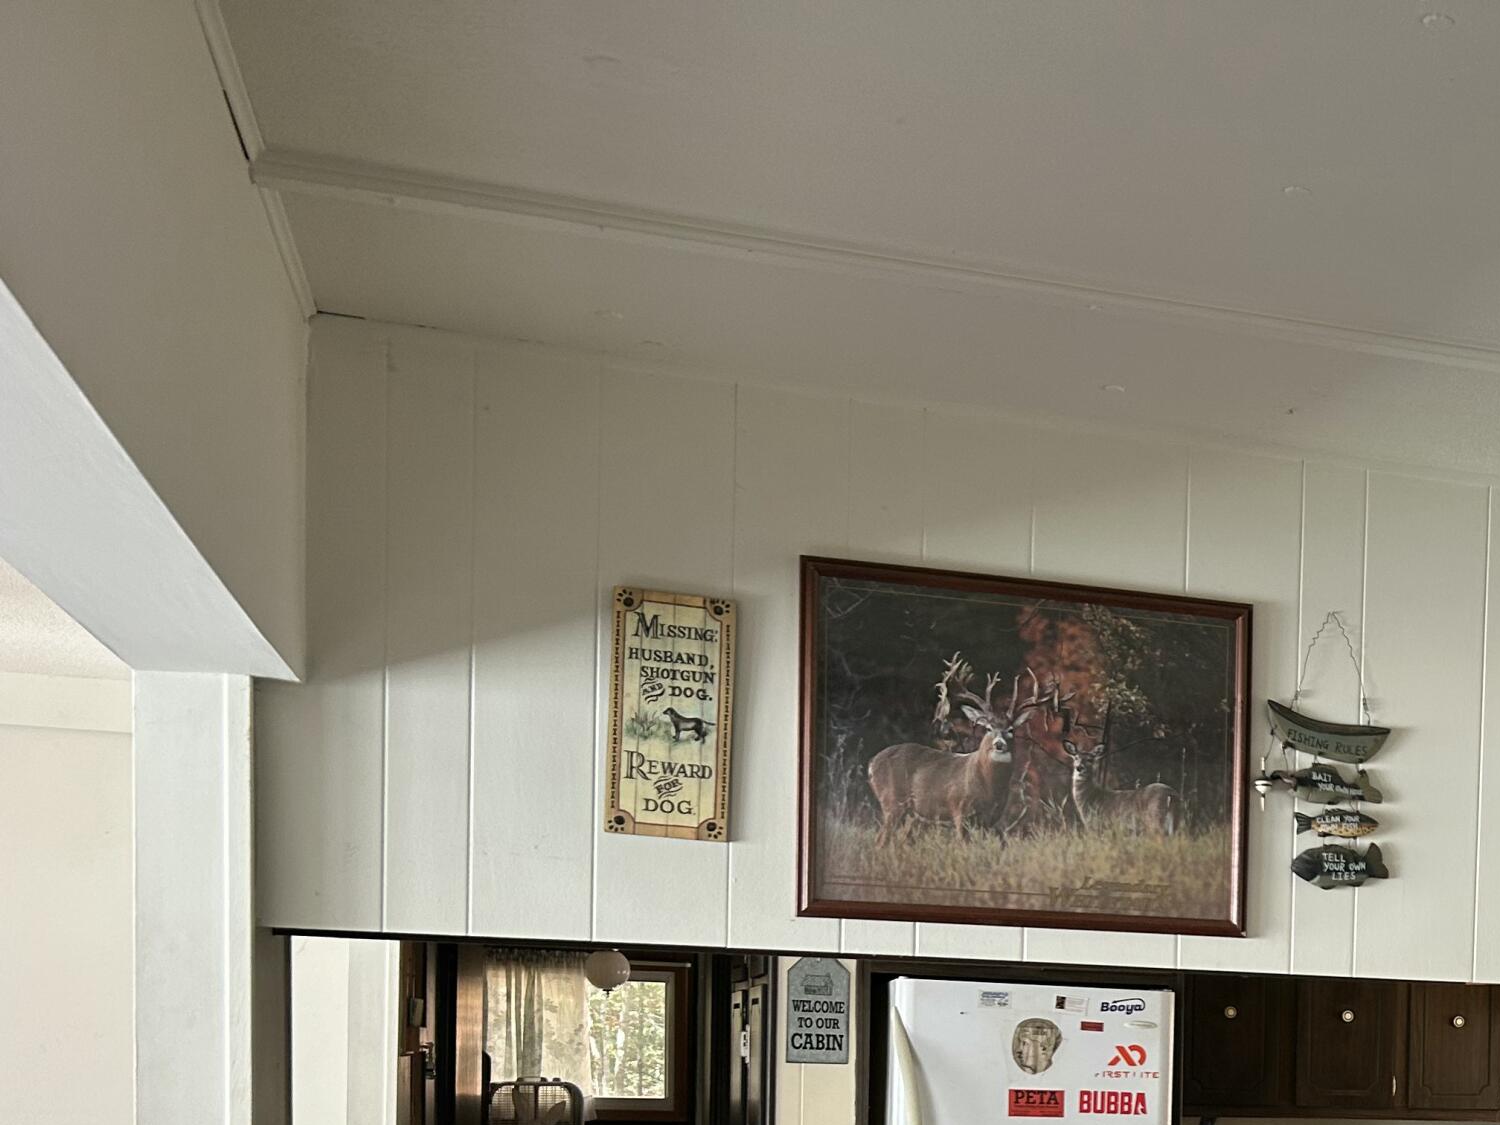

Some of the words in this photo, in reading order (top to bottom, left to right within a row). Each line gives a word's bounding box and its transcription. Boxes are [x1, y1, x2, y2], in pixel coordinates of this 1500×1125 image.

[632, 611, 718, 643] MISSING:
[628, 647, 715, 670] HUSBAND,
[640, 665, 717, 685] SHOTGUN
[642, 682, 664, 696] AND
[668, 685, 713, 701] DOG.
[1287, 729, 1330, 750] FISHING
[1335, 742, 1369, 756] RULES
[623, 750, 713, 780] REWARD
[1312, 771, 1332, 783] BAIT
[655, 778, 681, 794] FOR
[1317, 782, 1335, 793] YOUR
[1335, 784, 1350, 796] OWN
[642, 798, 697, 815] DOG.
[1316, 815, 1341, 824] CLEAN
[1342, 815, 1361, 824] YOUR
[1320, 823, 1339, 831] OWN
[1342, 823, 1359, 831] FISH
[1322, 852, 1347, 863] TELL
[1323, 862, 1346, 873] YOUR
[1348, 862, 1367, 872] OWN
[1331, 871, 1357, 881] LIES
[792, 999, 846, 1014] WELCOME
[1100, 1000, 1144, 1015] Booya
[797, 1016, 813, 1029] TO
[815, 1017, 841, 1029] OUR
[790, 1032, 844, 1051] CABIN
[1014, 1089, 1060, 1105] PETA
[1079, 1090, 1148, 1115] BUBBA
